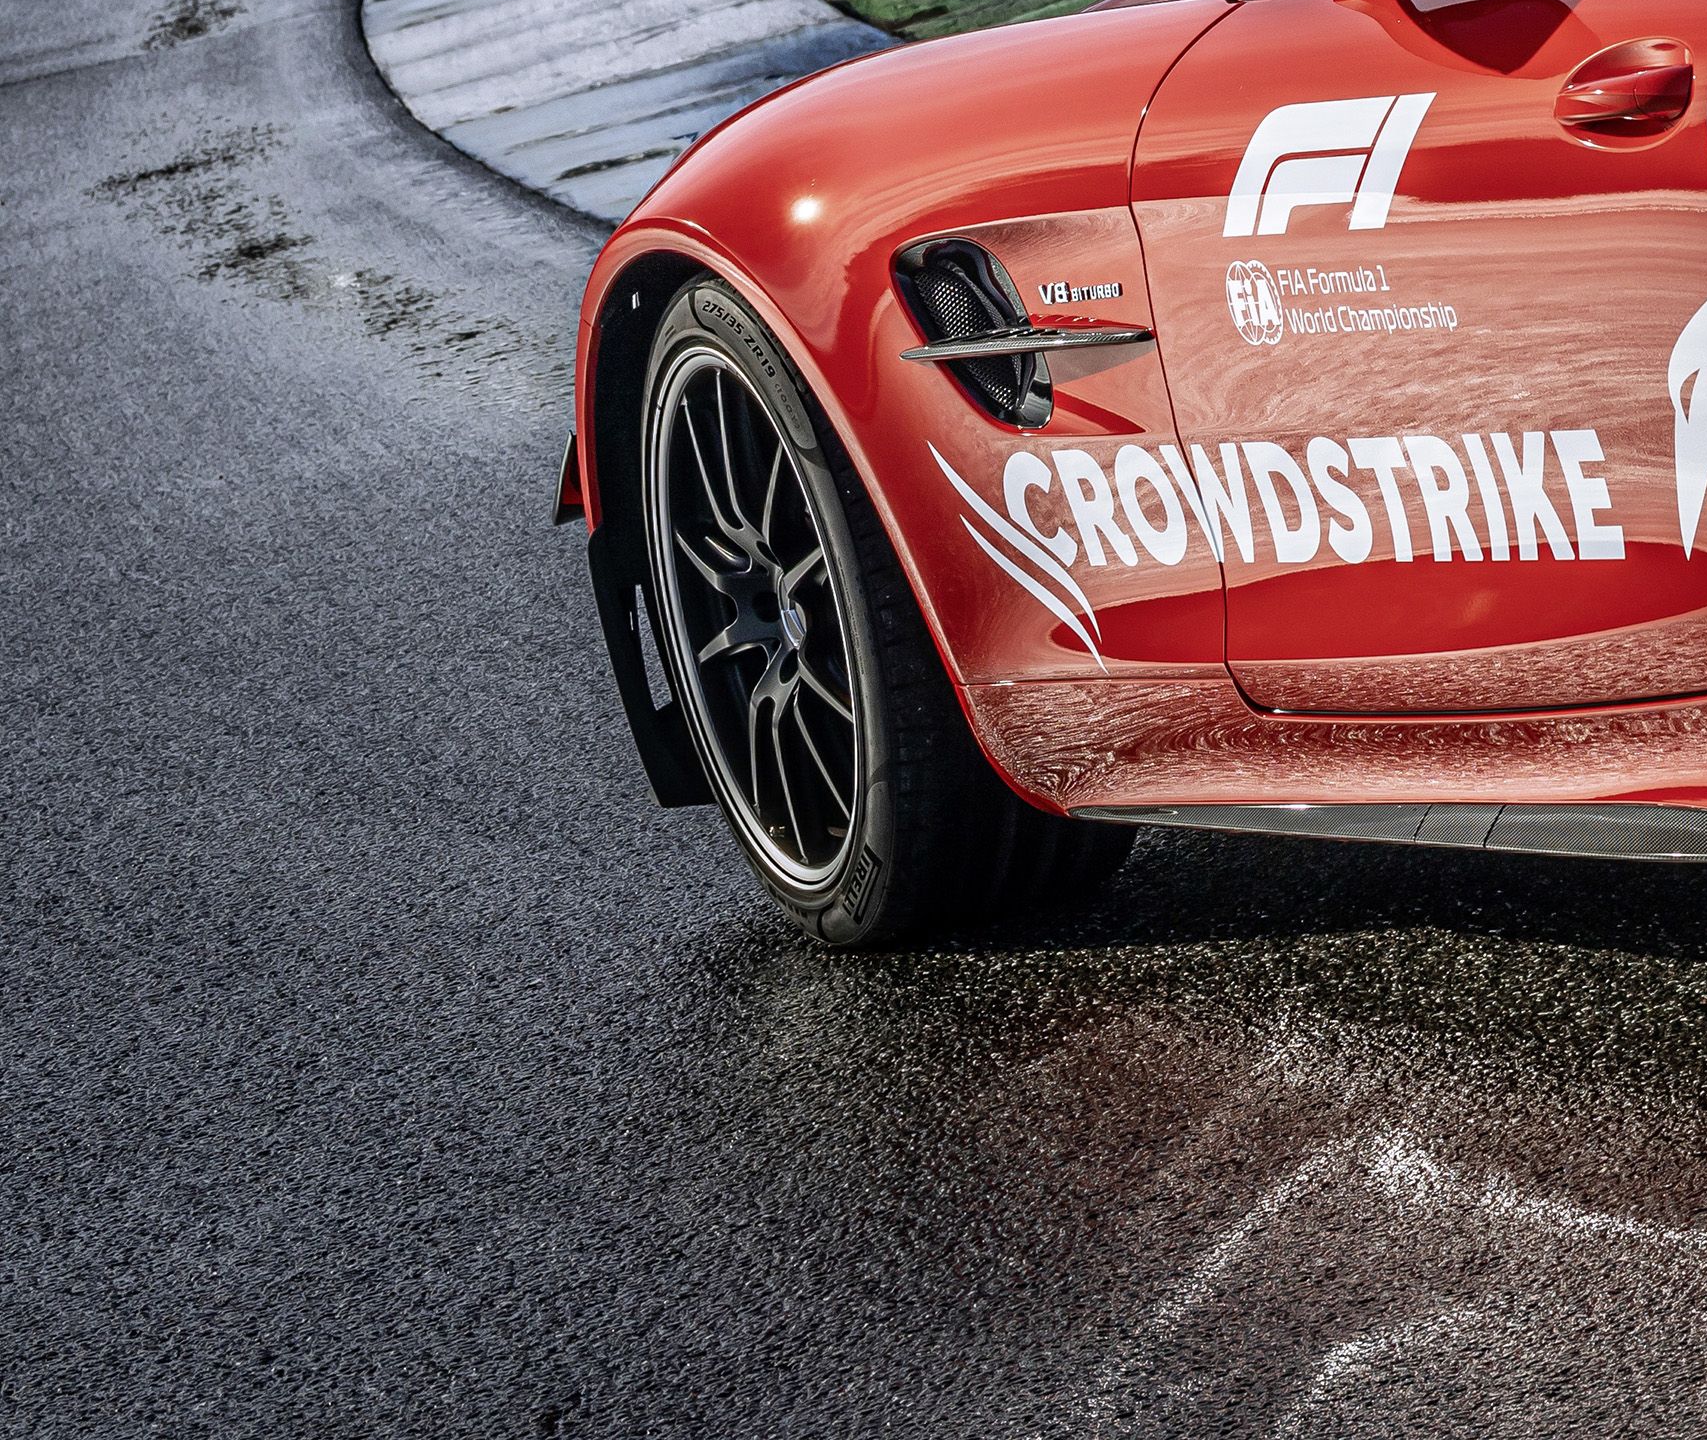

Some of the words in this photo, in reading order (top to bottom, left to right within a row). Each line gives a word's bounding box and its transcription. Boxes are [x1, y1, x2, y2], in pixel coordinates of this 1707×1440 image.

[1038, 281, 1069, 305] V8
[1070, 282, 1123, 302] BITURBO
[1277, 269, 1308, 296] FIA
[1307, 266, 1377, 296] Formula
[1376, 264, 1391, 292] 1
[1284, 307, 1338, 335] World
[1338, 302, 1458, 335] Championship
[702, 300, 745, 335] 275/35
[744, 335, 777, 379] ZR19
[1002, 429, 1626, 565] CROWDSTRIKE
